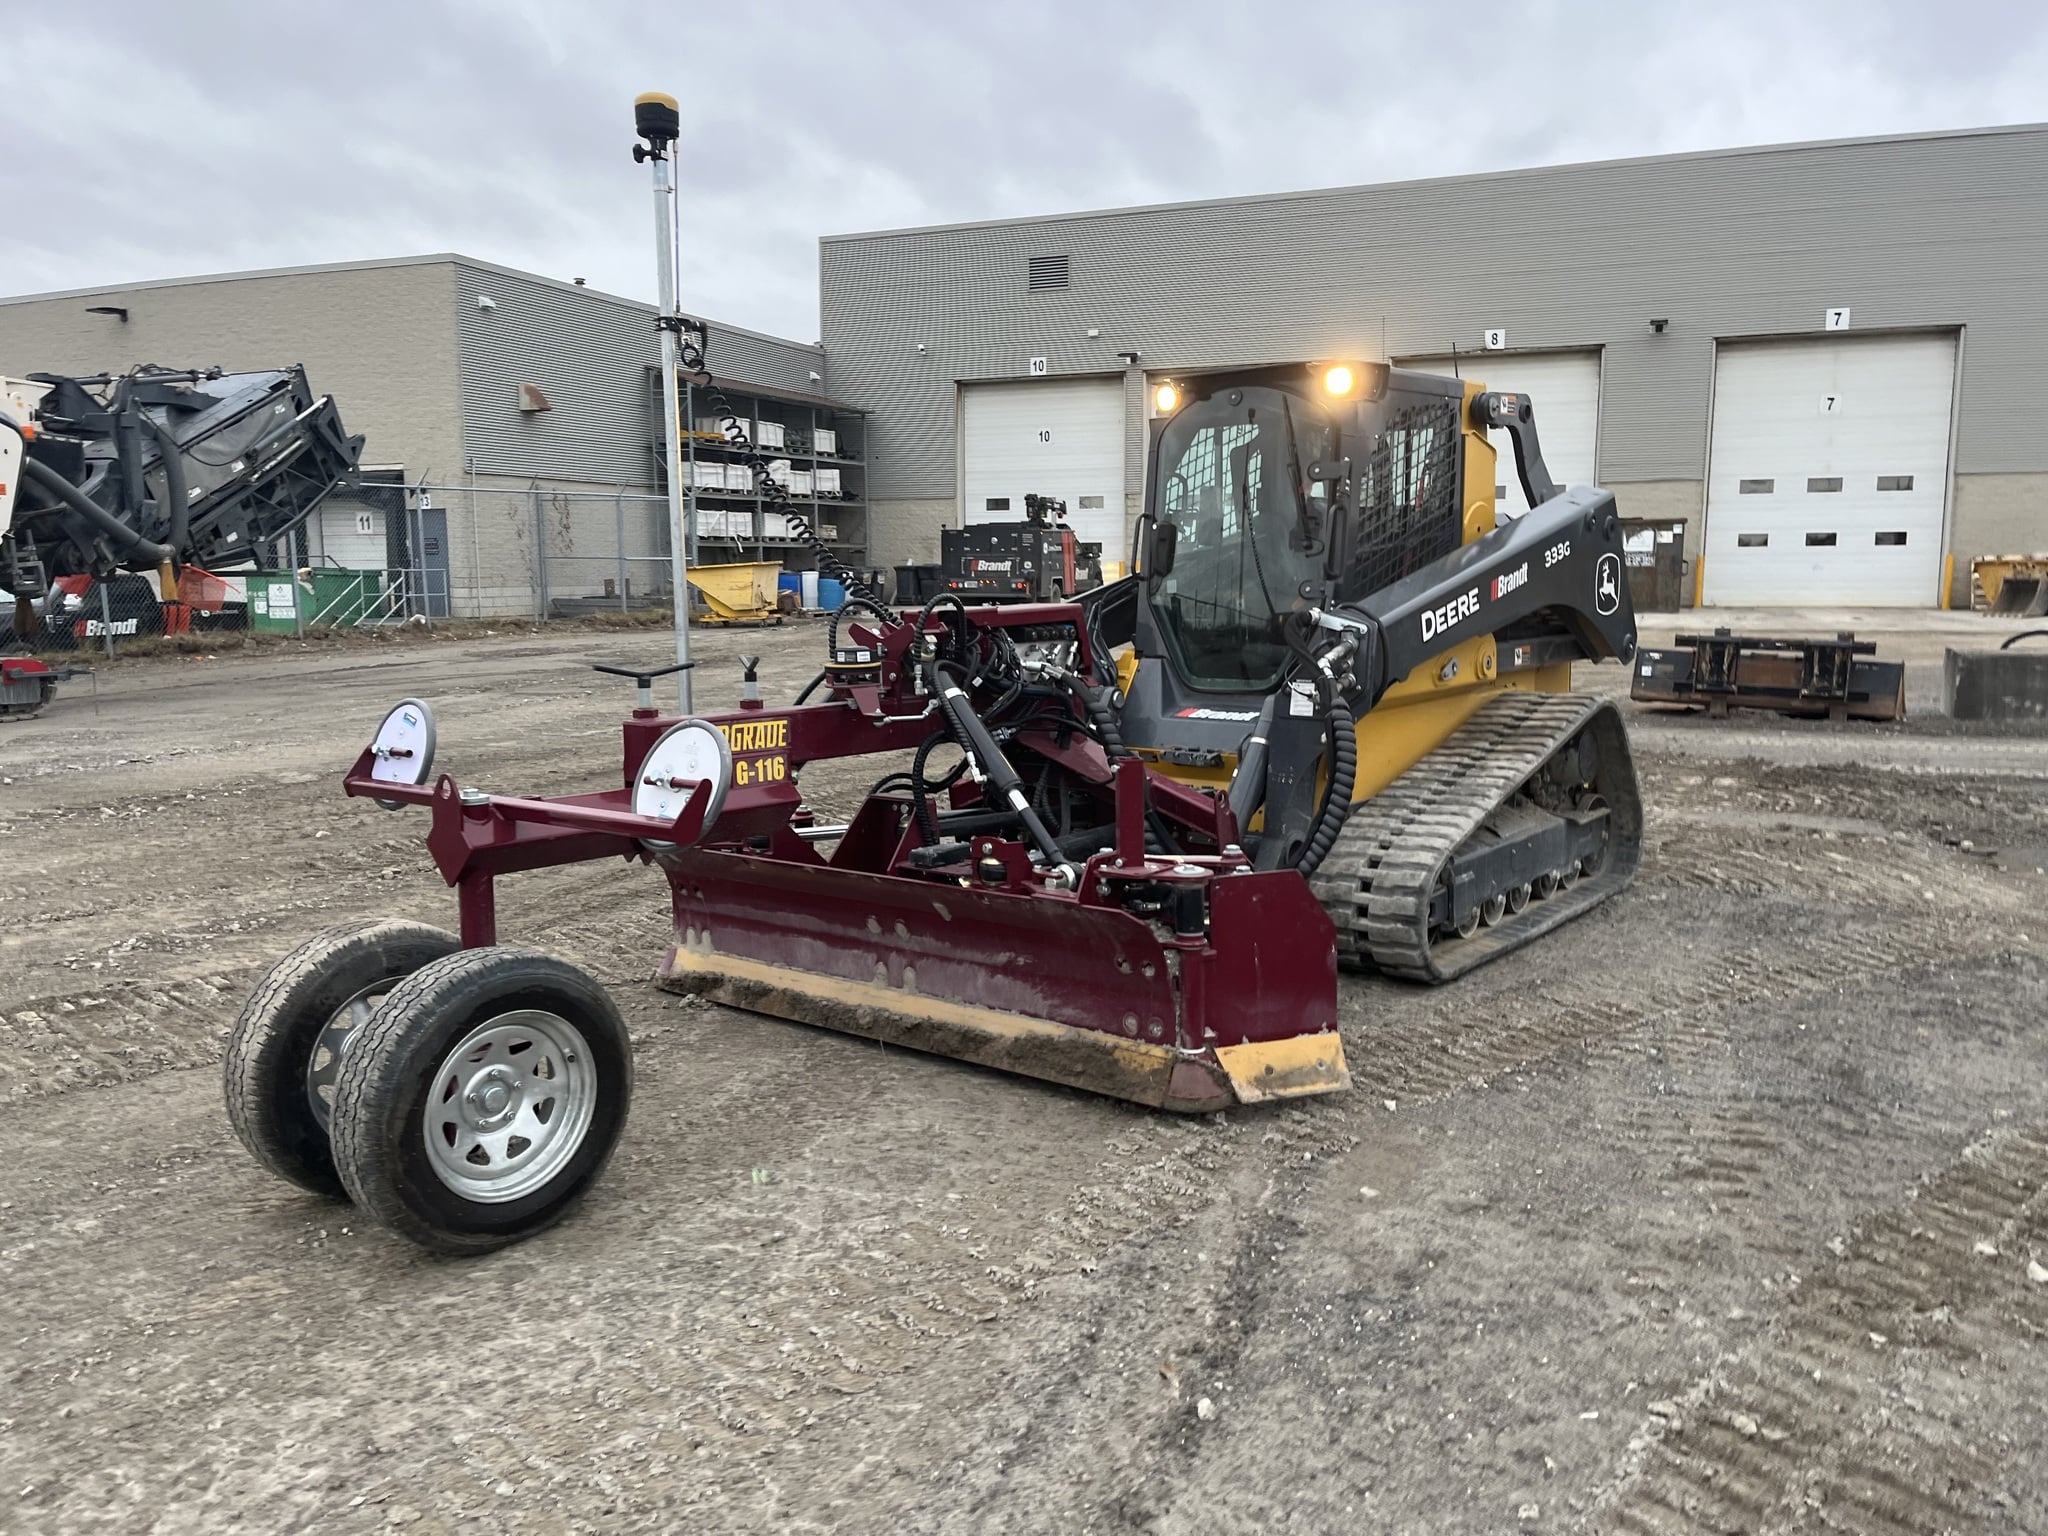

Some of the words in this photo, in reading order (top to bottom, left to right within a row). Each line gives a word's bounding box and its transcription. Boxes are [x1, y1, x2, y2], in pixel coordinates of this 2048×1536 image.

[1834, 312, 1842, 326] 7
[1491, 332, 1498, 346] 8
[1033, 360, 1044, 372] 10
[1827, 397, 1835, 411] 7
[1039, 430, 1050, 442] 10
[359, 516, 371, 530] 11
[1544, 541, 1571, 568] 333G
[978, 560, 1012, 571] Brandt
[1497, 562, 1528, 599] Brandt
[1421, 587, 1480, 643] DEERE
[736, 756, 785, 785] G-116
